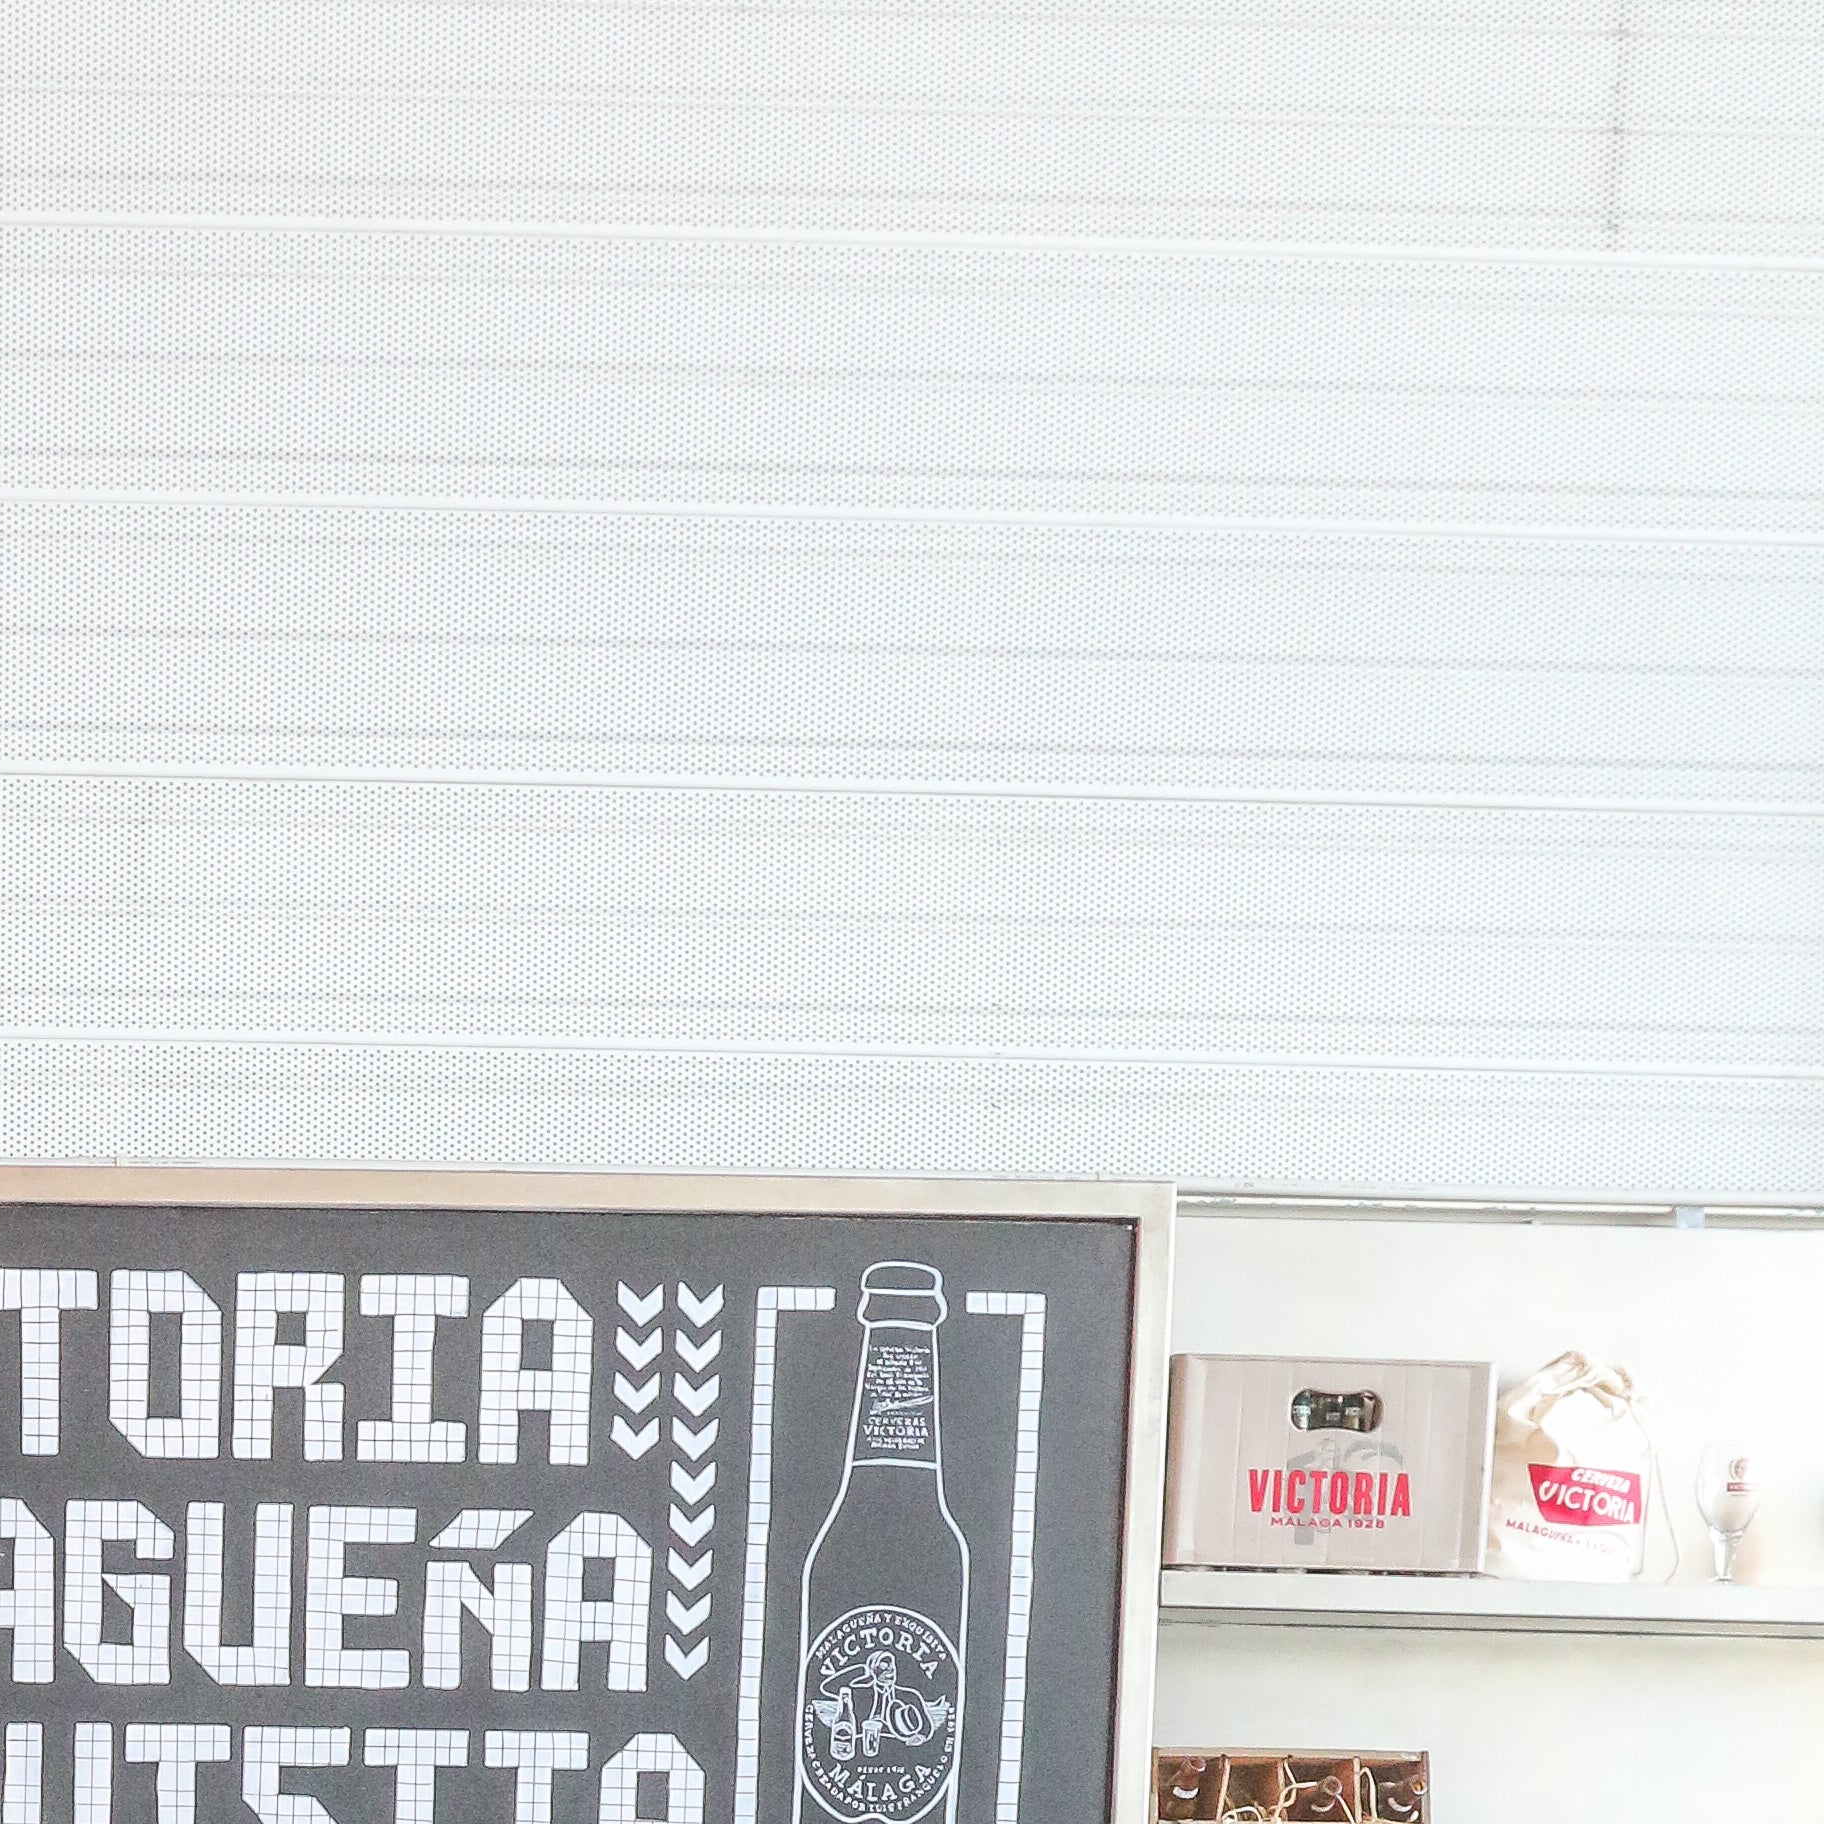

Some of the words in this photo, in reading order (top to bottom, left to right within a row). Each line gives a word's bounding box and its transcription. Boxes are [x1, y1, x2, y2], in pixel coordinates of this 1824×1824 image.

[863, 1425, 928, 1436] VICTORIA
[1249, 1469, 1411, 1517] VICTORIA
[1539, 1480, 1635, 1524] VICTORIA
[819, 1627, 940, 1680] VICTORIA
[828, 1763, 933, 1802] MÁLAGA
